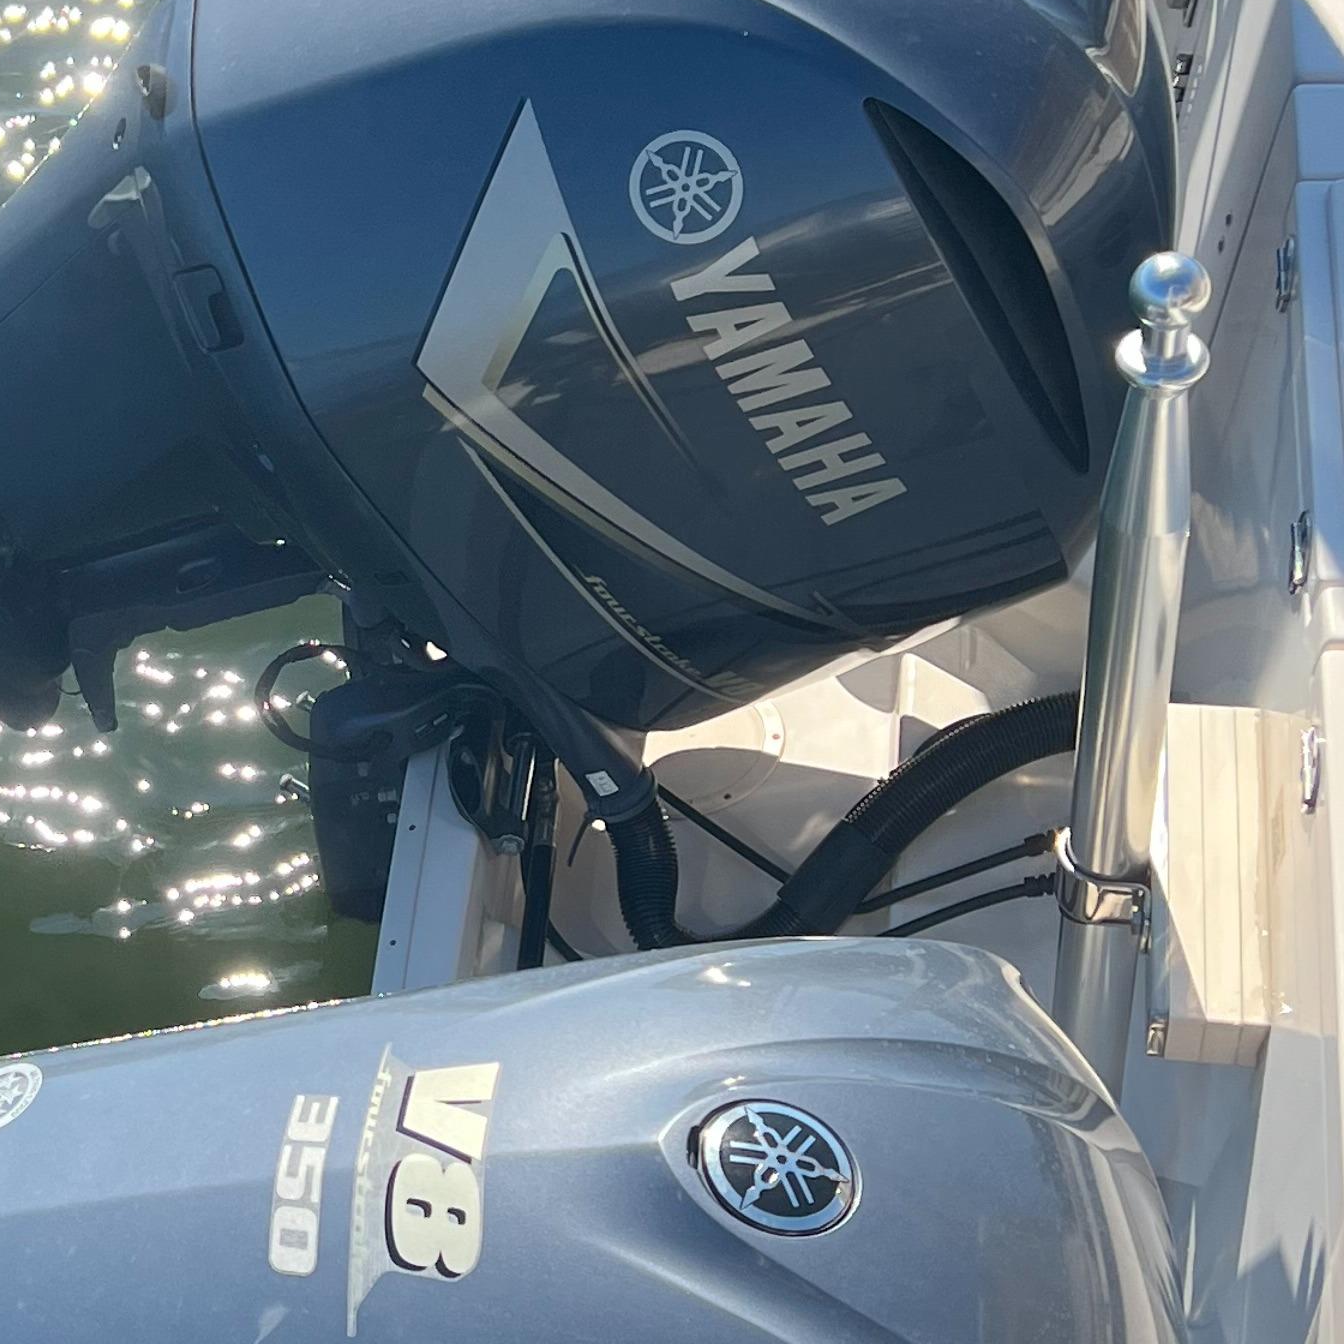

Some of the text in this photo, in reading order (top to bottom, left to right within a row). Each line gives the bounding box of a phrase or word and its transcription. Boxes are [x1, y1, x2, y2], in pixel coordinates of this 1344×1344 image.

[670, 236, 907, 526] YAMAHA
[269, 1095, 339, 1276] 350
[386, 1062, 500, 1278] V8
